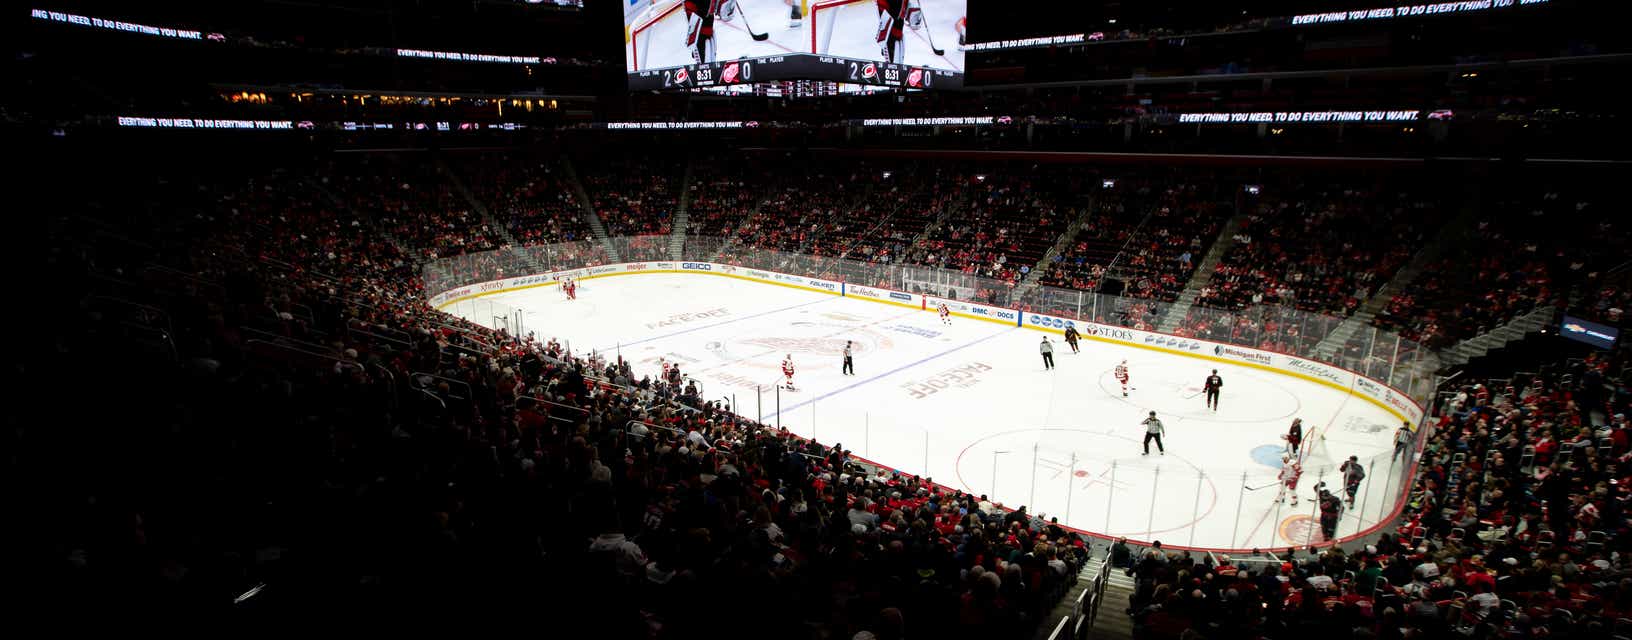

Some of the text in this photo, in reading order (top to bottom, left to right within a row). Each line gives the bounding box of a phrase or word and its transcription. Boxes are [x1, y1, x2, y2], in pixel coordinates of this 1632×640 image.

[1292, 13, 1347, 24] EVERYTHING
[1348, 10, 1368, 20] YOU
[1396, 6, 1410, 16] TO
[1410, 6, 1426, 15] DO
[1426, 0, 1491, 14] EVERYTHING
[48, 11, 66, 21] YOU
[92, 18, 102, 27] TO
[104, 20, 114, 28] DO
[116, 22, 160, 35] EVERYTHING
[160, 28, 176, 37] YOU
[397, 49, 433, 58] EVERYTHING
[664, 62, 750, 88] 2 8:31 0
[850, 62, 932, 86] 2 8:31 0
[1180, 114, 1230, 122] EVERYTHING
[1231, 113, 1248, 121] YOU
[1275, 112, 1287, 121] TO
[1288, 112, 1301, 121] DO
[1302, 112, 1362, 121] EVERYTHING
[1364, 111, 1384, 120] YOU
[118, 117, 156, 126] EVERYTHING
[157, 118, 172, 127] YOU
[194, 120, 203, 128] TO
[204, 120, 214, 128] DO
[215, 120, 254, 128] EVERYTHING
[626, 262, 647, 271] meijer
[682, 262, 711, 270] GEICO
[480, 281, 504, 292] xfinity
[1225, 348, 1255, 359] Michigan
[1255, 353, 1271, 361] First
